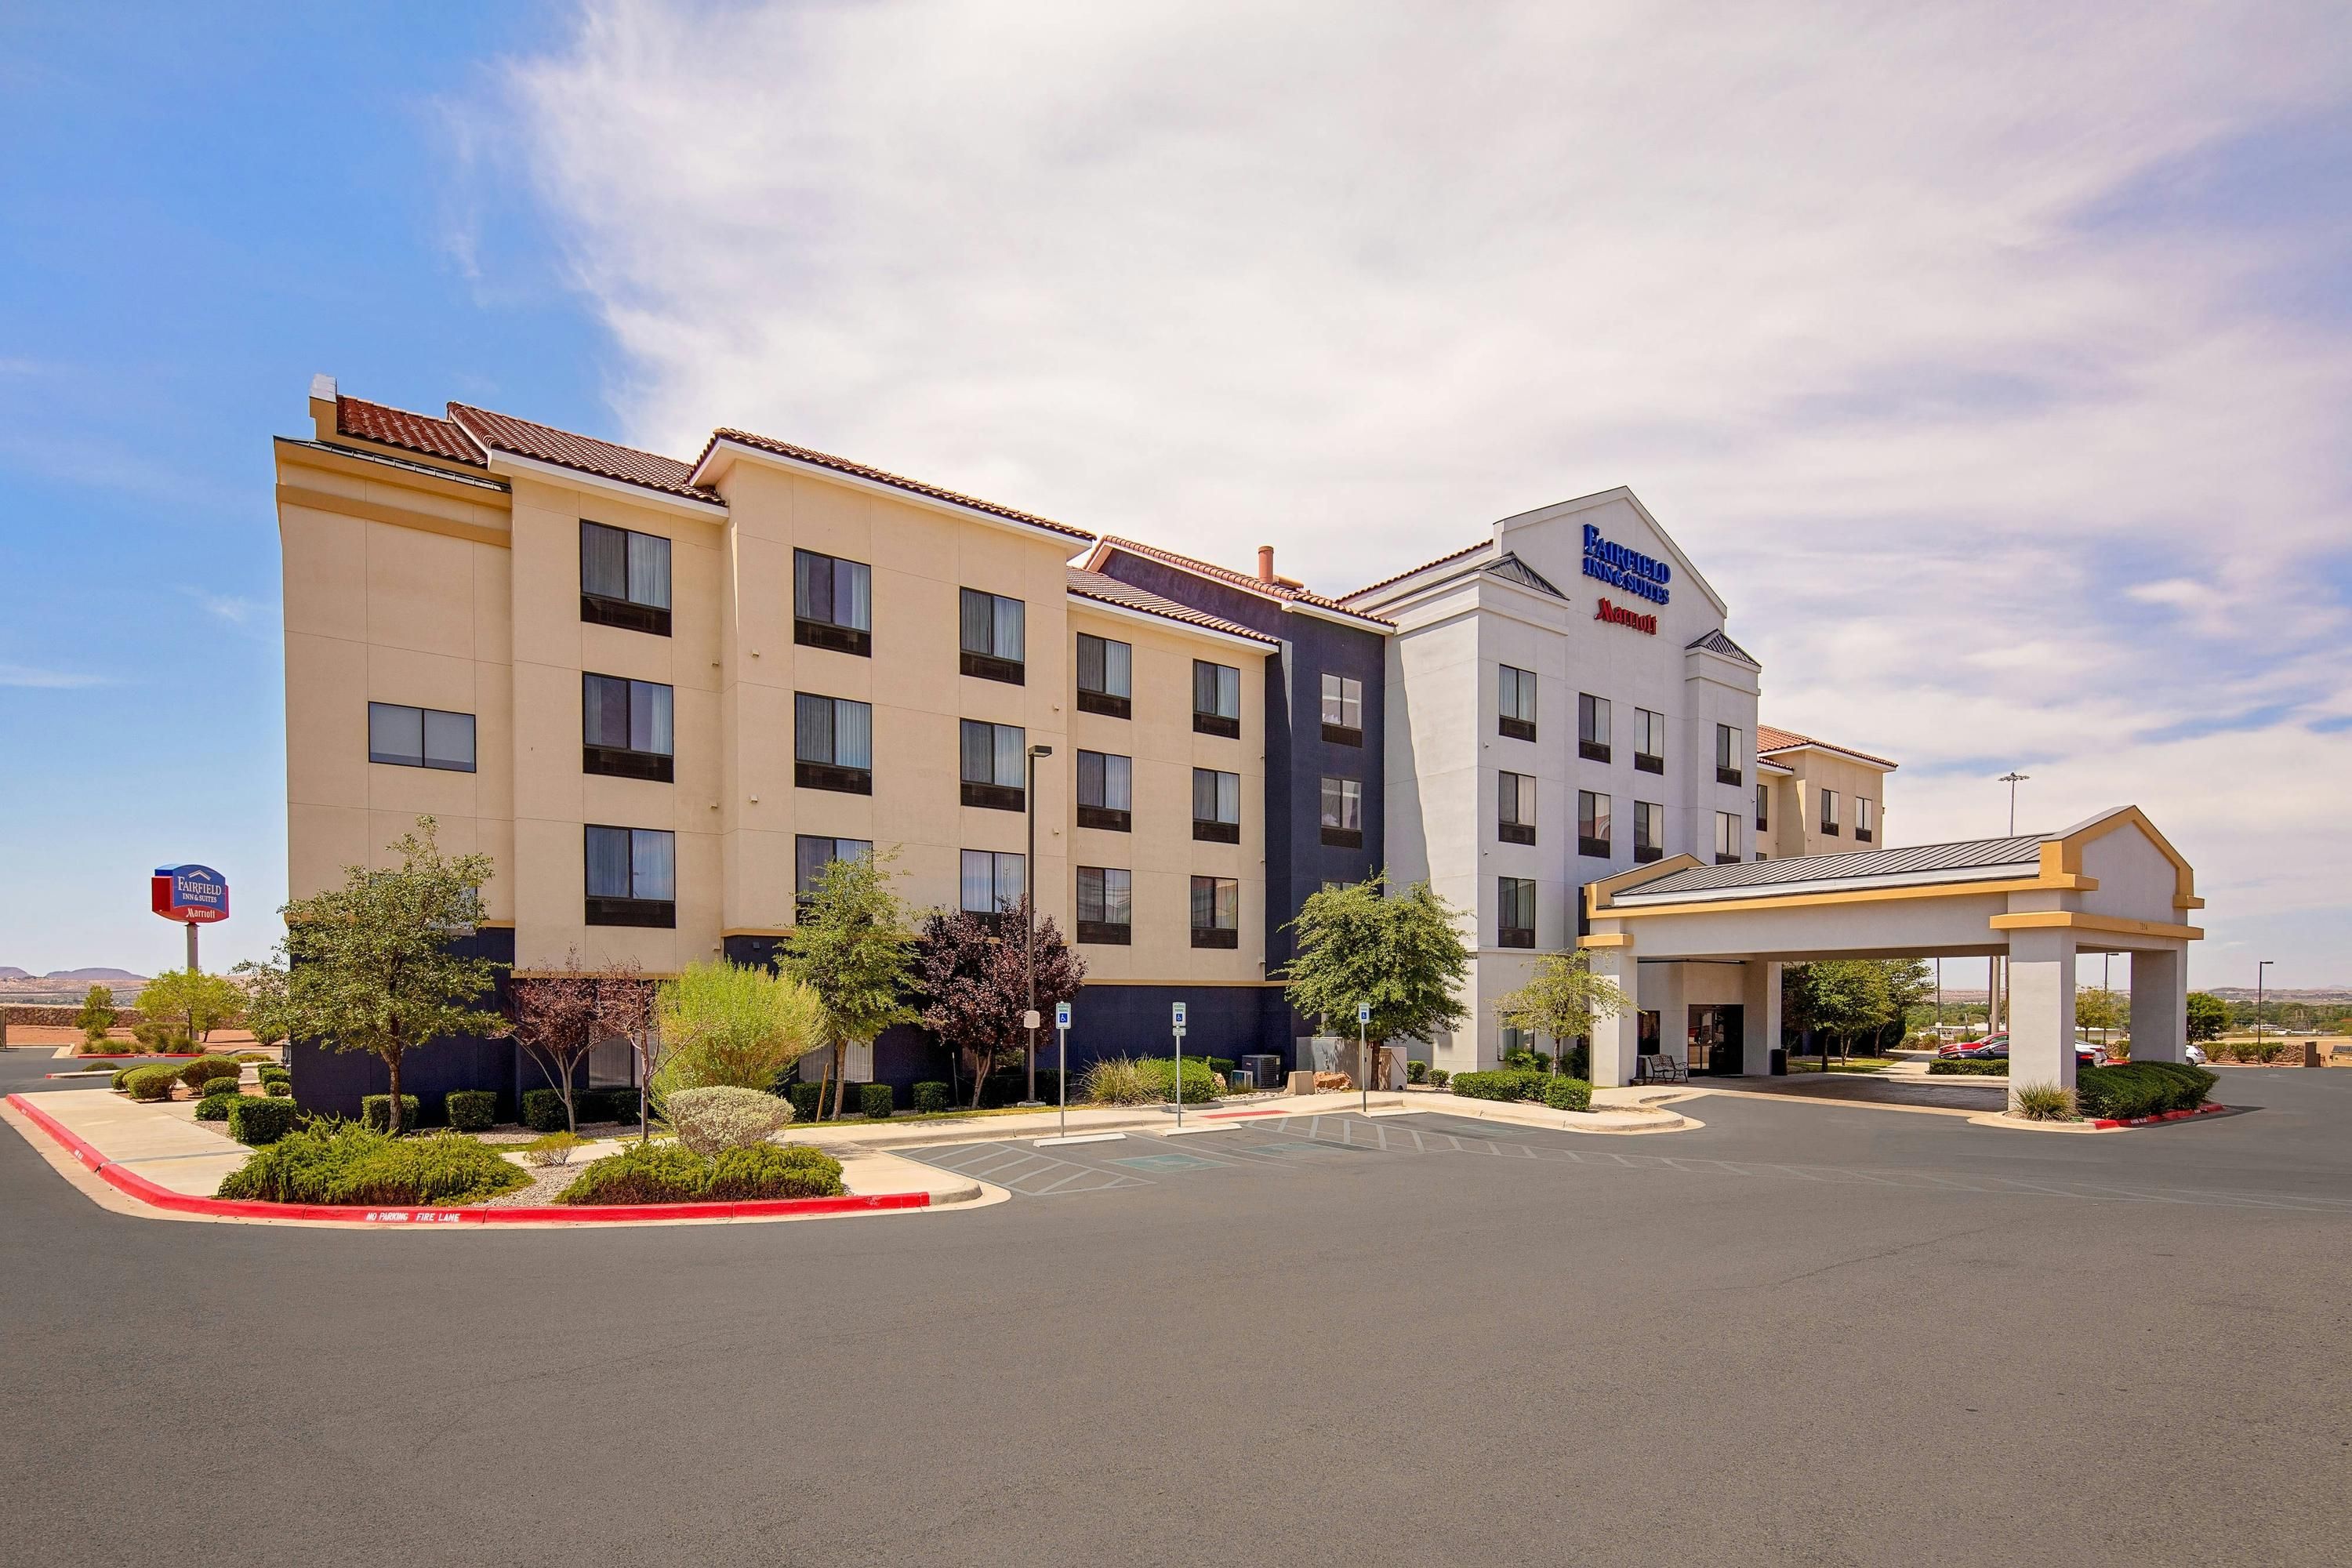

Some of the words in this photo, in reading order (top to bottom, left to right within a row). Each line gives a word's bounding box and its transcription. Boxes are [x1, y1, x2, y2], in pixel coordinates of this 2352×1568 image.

[1583, 524, 1671, 584] FAIRFIELD
[1582, 557, 1613, 583] INN
[1622, 573, 1670, 605] SUITES
[1594, 597, 1657, 635] Marriott
[177, 876, 222, 895] FAIRFIELD
[186, 907, 216, 919] Marriott
[366, 1212, 377, 1221] NO
[379, 1212, 408, 1221] PARKING
[416, 1213, 434, 1221] FIRE
[438, 1213, 460, 1223] LANE
